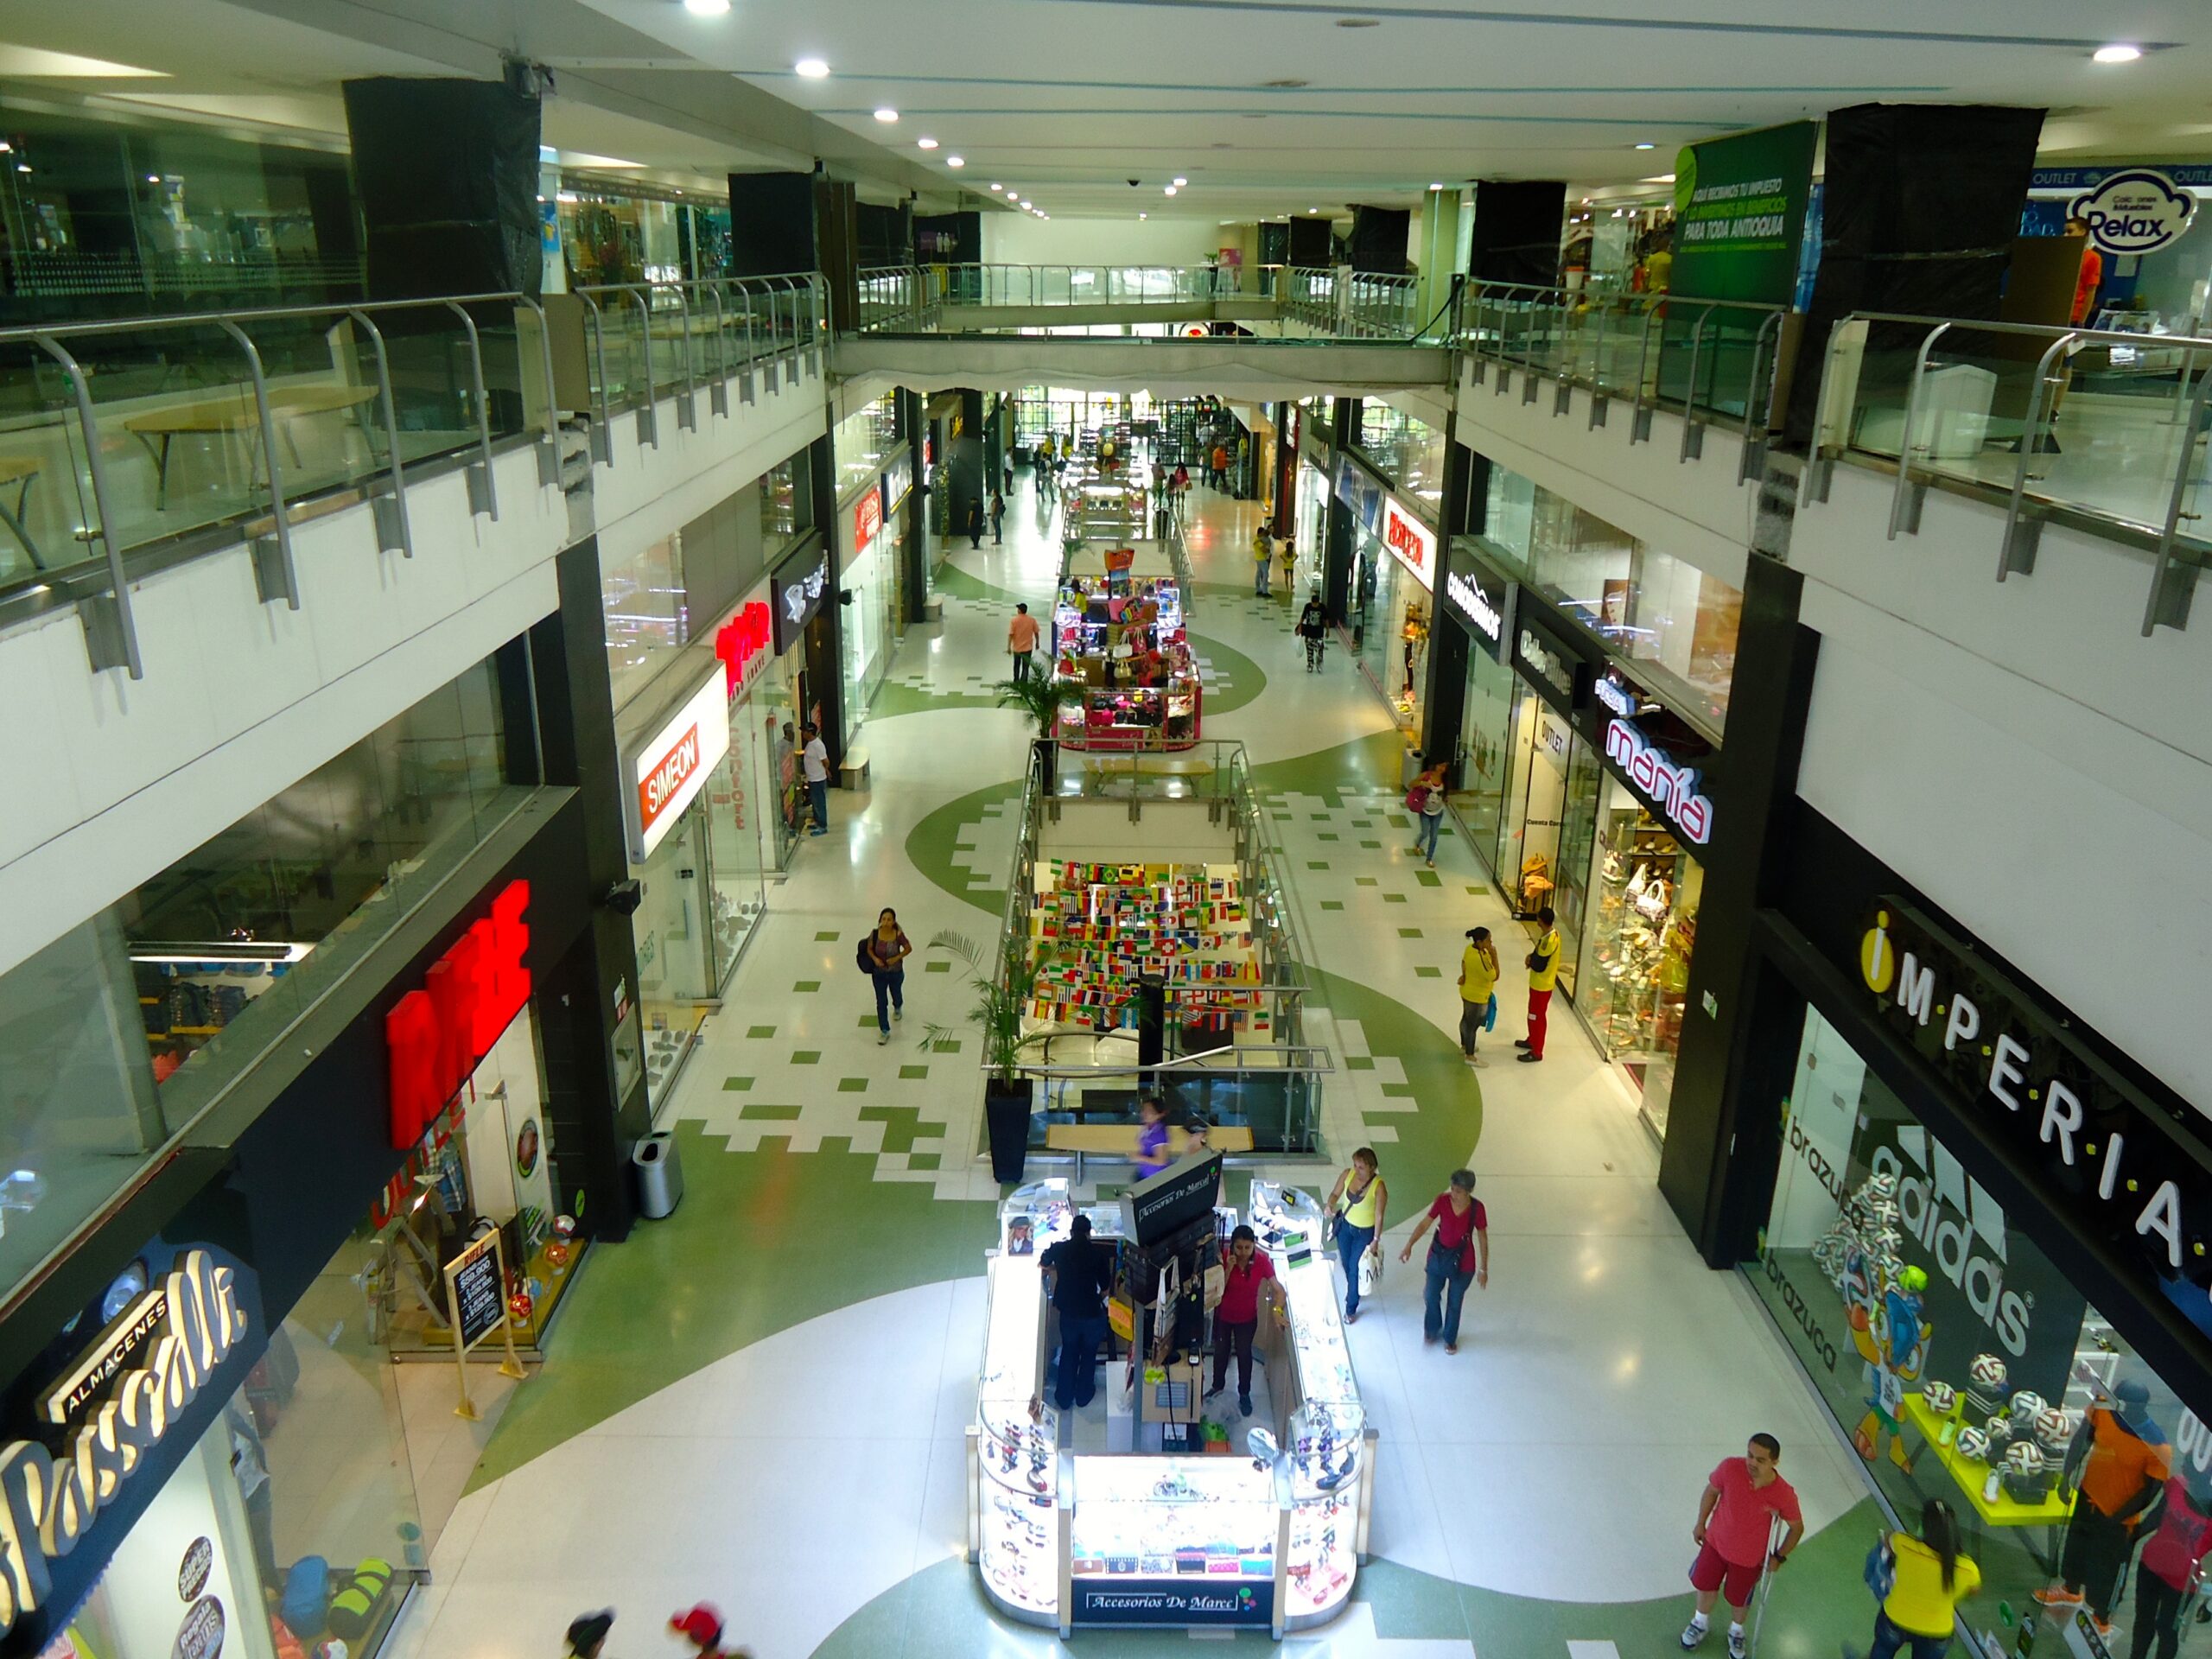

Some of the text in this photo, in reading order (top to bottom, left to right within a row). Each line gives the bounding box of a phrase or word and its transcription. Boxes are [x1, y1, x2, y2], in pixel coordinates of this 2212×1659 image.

[2032, 172, 2077, 185] OUTLET
[1683, 215, 1784, 241] PARA TODA ANTIOQUIA
[2088, 211, 2164, 238] Relax
[1541, 719, 1563, 756] OUTLET
[647, 735, 696, 814] SIMEON
[1861, 911, 2209, 1279] IMPERIA
[464, 1243, 486, 1268] RIFLE
[1872, 1145, 2030, 1357] adidas
[1766, 1249, 1837, 1374] brazuca
[67, 1300, 166, 1414] ALMACENES
[180, 1541, 210, 1589] SUPER
[180, 1601, 212, 1650] Regala
[1091, 1596, 1162, 1608] Accesorios
[1166, 1596, 1186, 1608] De
